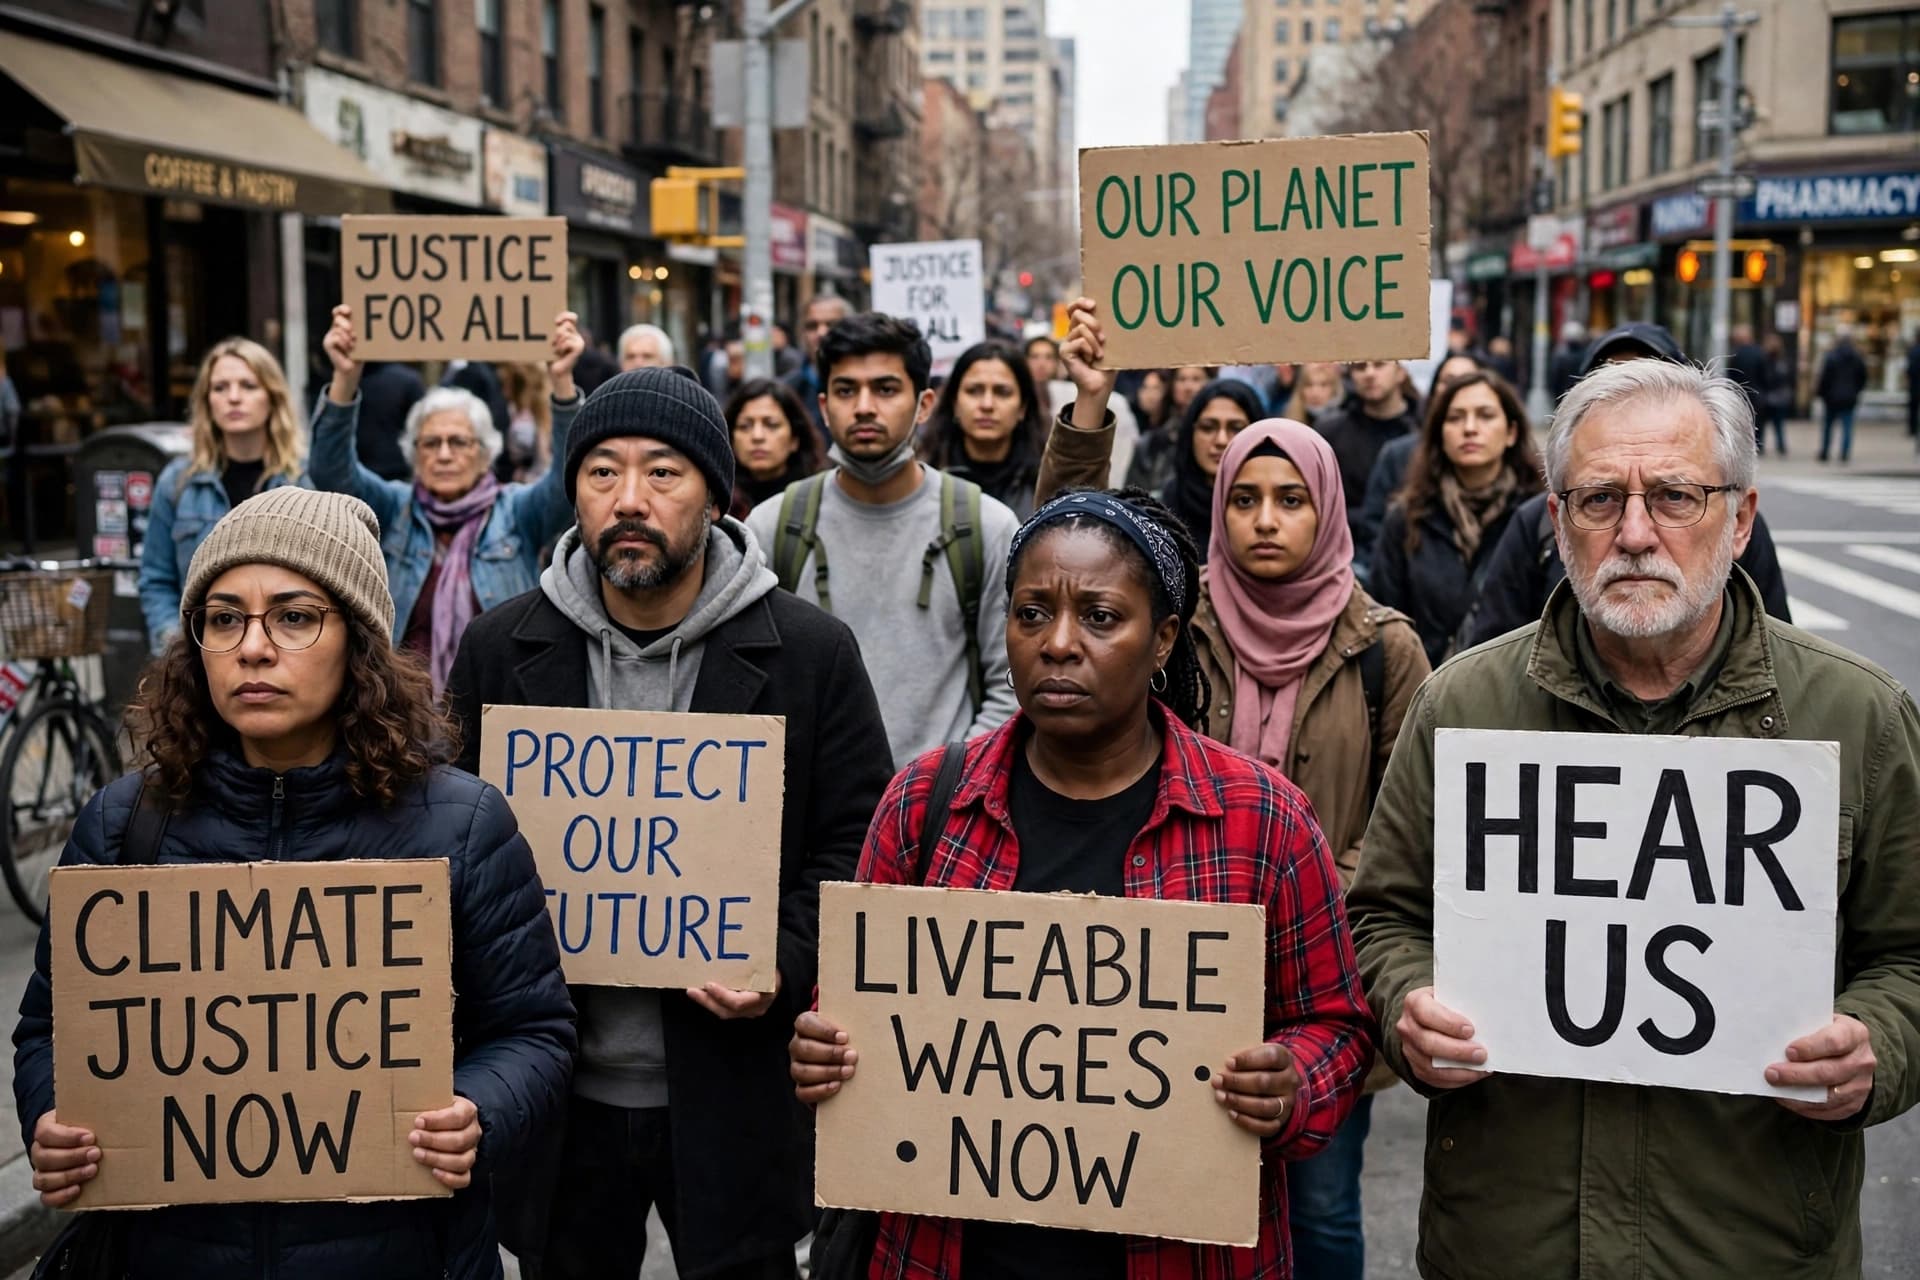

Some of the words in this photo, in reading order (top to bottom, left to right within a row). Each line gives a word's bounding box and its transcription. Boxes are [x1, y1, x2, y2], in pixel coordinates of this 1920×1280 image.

[1096, 172, 1200, 239] OUR
[1222, 161, 1415, 233] PLANET
[1756, 174, 1920, 219] PHARMACY
[356, 233, 552, 281] JUSTICE
[884, 251, 972, 281] JUSTICE
[1112, 262, 1224, 330] OUR
[1245, 254, 1404, 323] VOICE
[365, 294, 443, 341] FOR
[462, 295, 547, 341] ALL
[907, 284, 950, 311] FOR
[506, 729, 767, 802] PROTECT
[563, 815, 681, 877] OUR
[1466, 762, 1805, 911] HEAR
[75, 885, 423, 976] CLIMATE
[544, 889, 750, 962] UTURE
[855, 912, 1229, 1013] LIVEABLE
[1545, 919, 1716, 1055] US
[87, 989, 421, 1080] JUSTICE
[890, 1014, 1170, 1110] WAGES
[164, 1090, 361, 1182] NOW
[950, 1116, 1140, 1208] NOW
